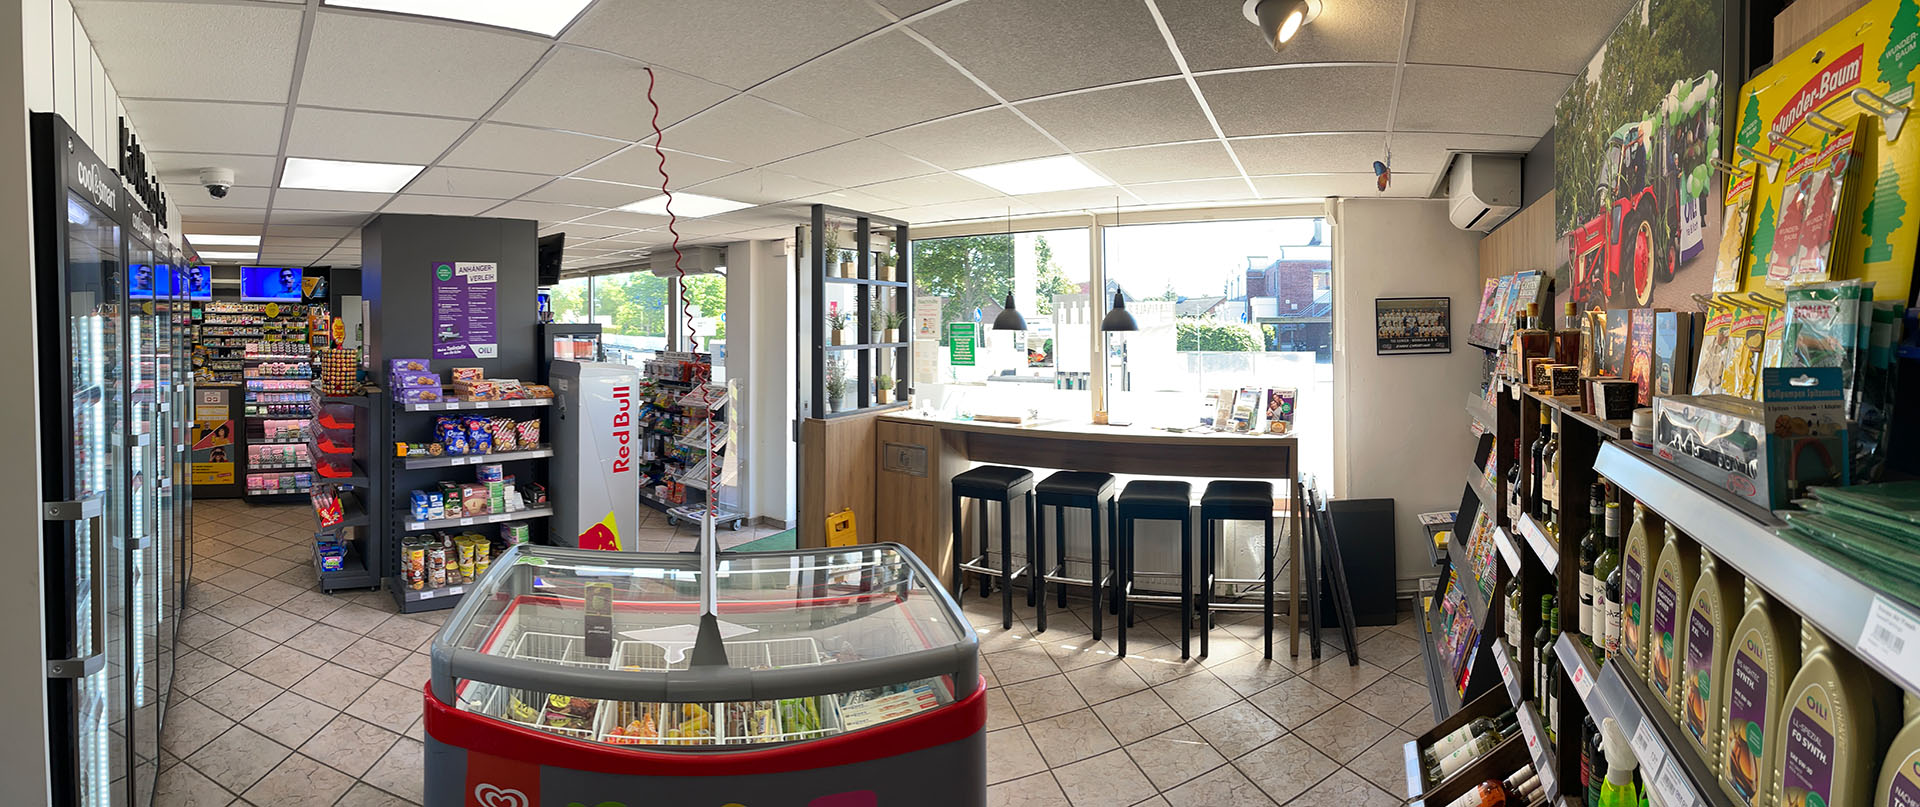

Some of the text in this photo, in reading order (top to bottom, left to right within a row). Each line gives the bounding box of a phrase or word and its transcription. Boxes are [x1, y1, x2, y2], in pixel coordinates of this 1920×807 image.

[1895, 41, 1917, 61] BAUM
[1772, 59, 1860, 145] Wunder-Baum
[469, 274, 494, 282] VERLEIH
[613, 386, 630, 473] Red Bull
[1736, 668, 1755, 690] SYNTH.
[1792, 718, 1823, 747] LL-SPEZIAL
[1801, 737, 1827, 765] SYNTH.
